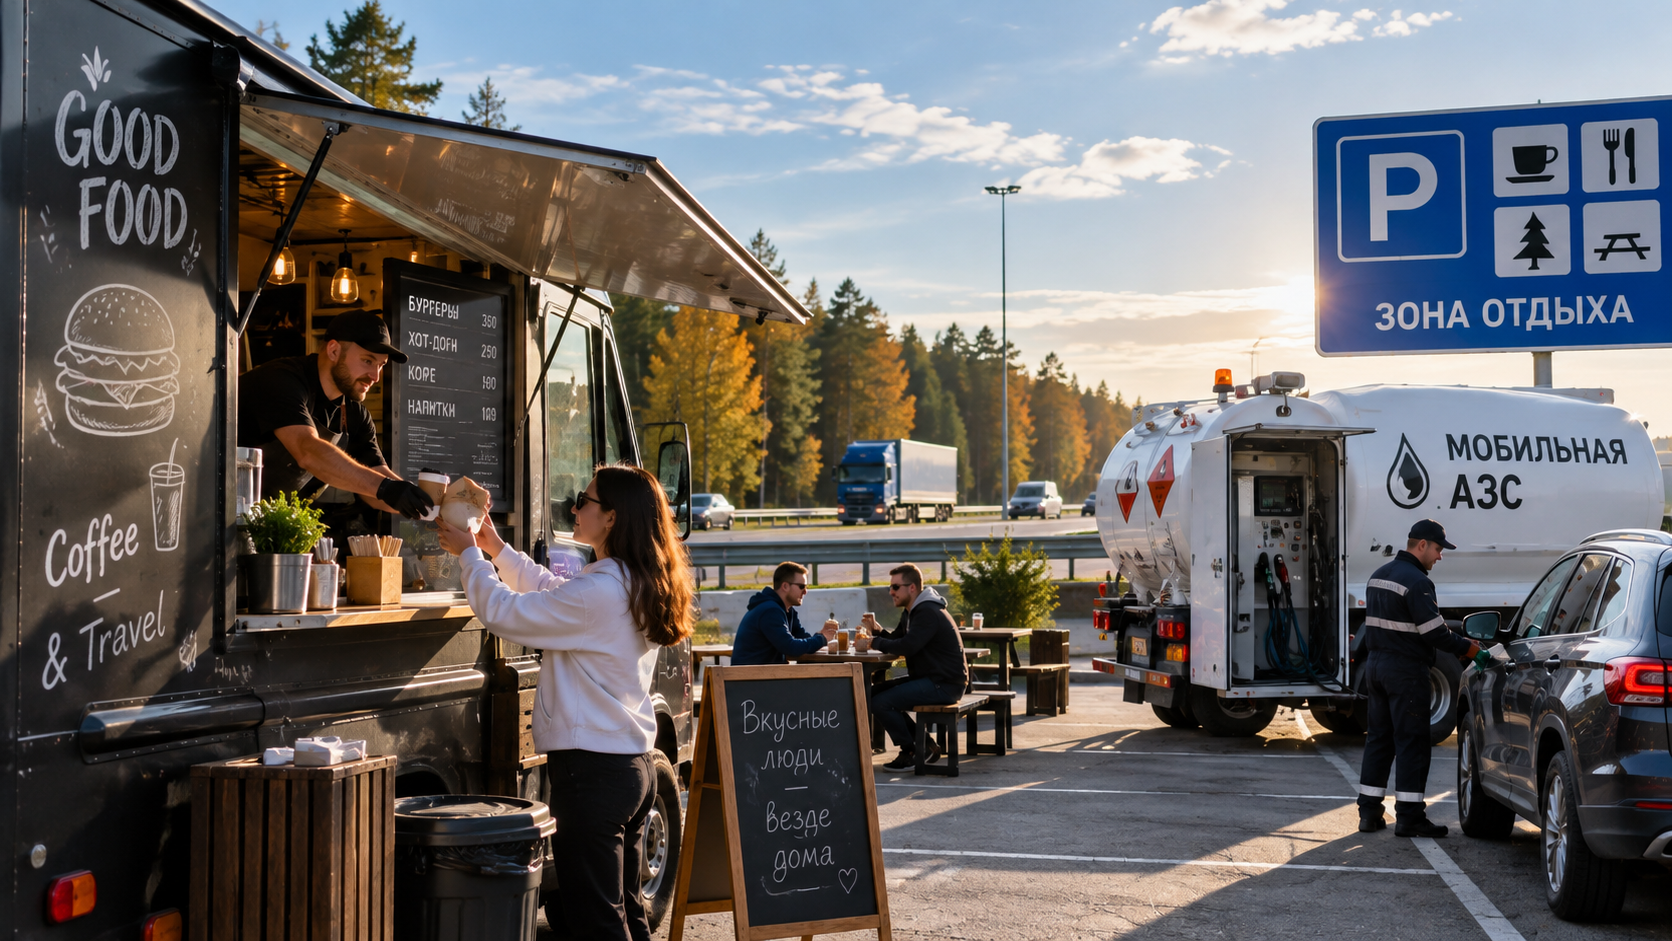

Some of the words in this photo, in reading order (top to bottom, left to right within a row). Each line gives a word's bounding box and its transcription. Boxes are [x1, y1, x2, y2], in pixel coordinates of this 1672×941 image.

[55, 90, 180, 175] GOOD
[79, 176, 188, 250] FOOD
[1369, 152, 1438, 241] P
[1375, 300, 1470, 331] ЗОНА
[1482, 295, 1634, 331] ОТДЫХА
[1445, 433, 1628, 465] МОБИЛЬНАЯ
[1449, 474, 1523, 510] АЗС
[45, 513, 139, 587] Coffee
[42, 632, 68, 690] &
[79, 589, 166, 671] Travel
[741, 699, 840, 742] Вкусные
[761, 748, 824, 776] люди
[766, 801, 832, 837] везде
[773, 846, 835, 883] дома
